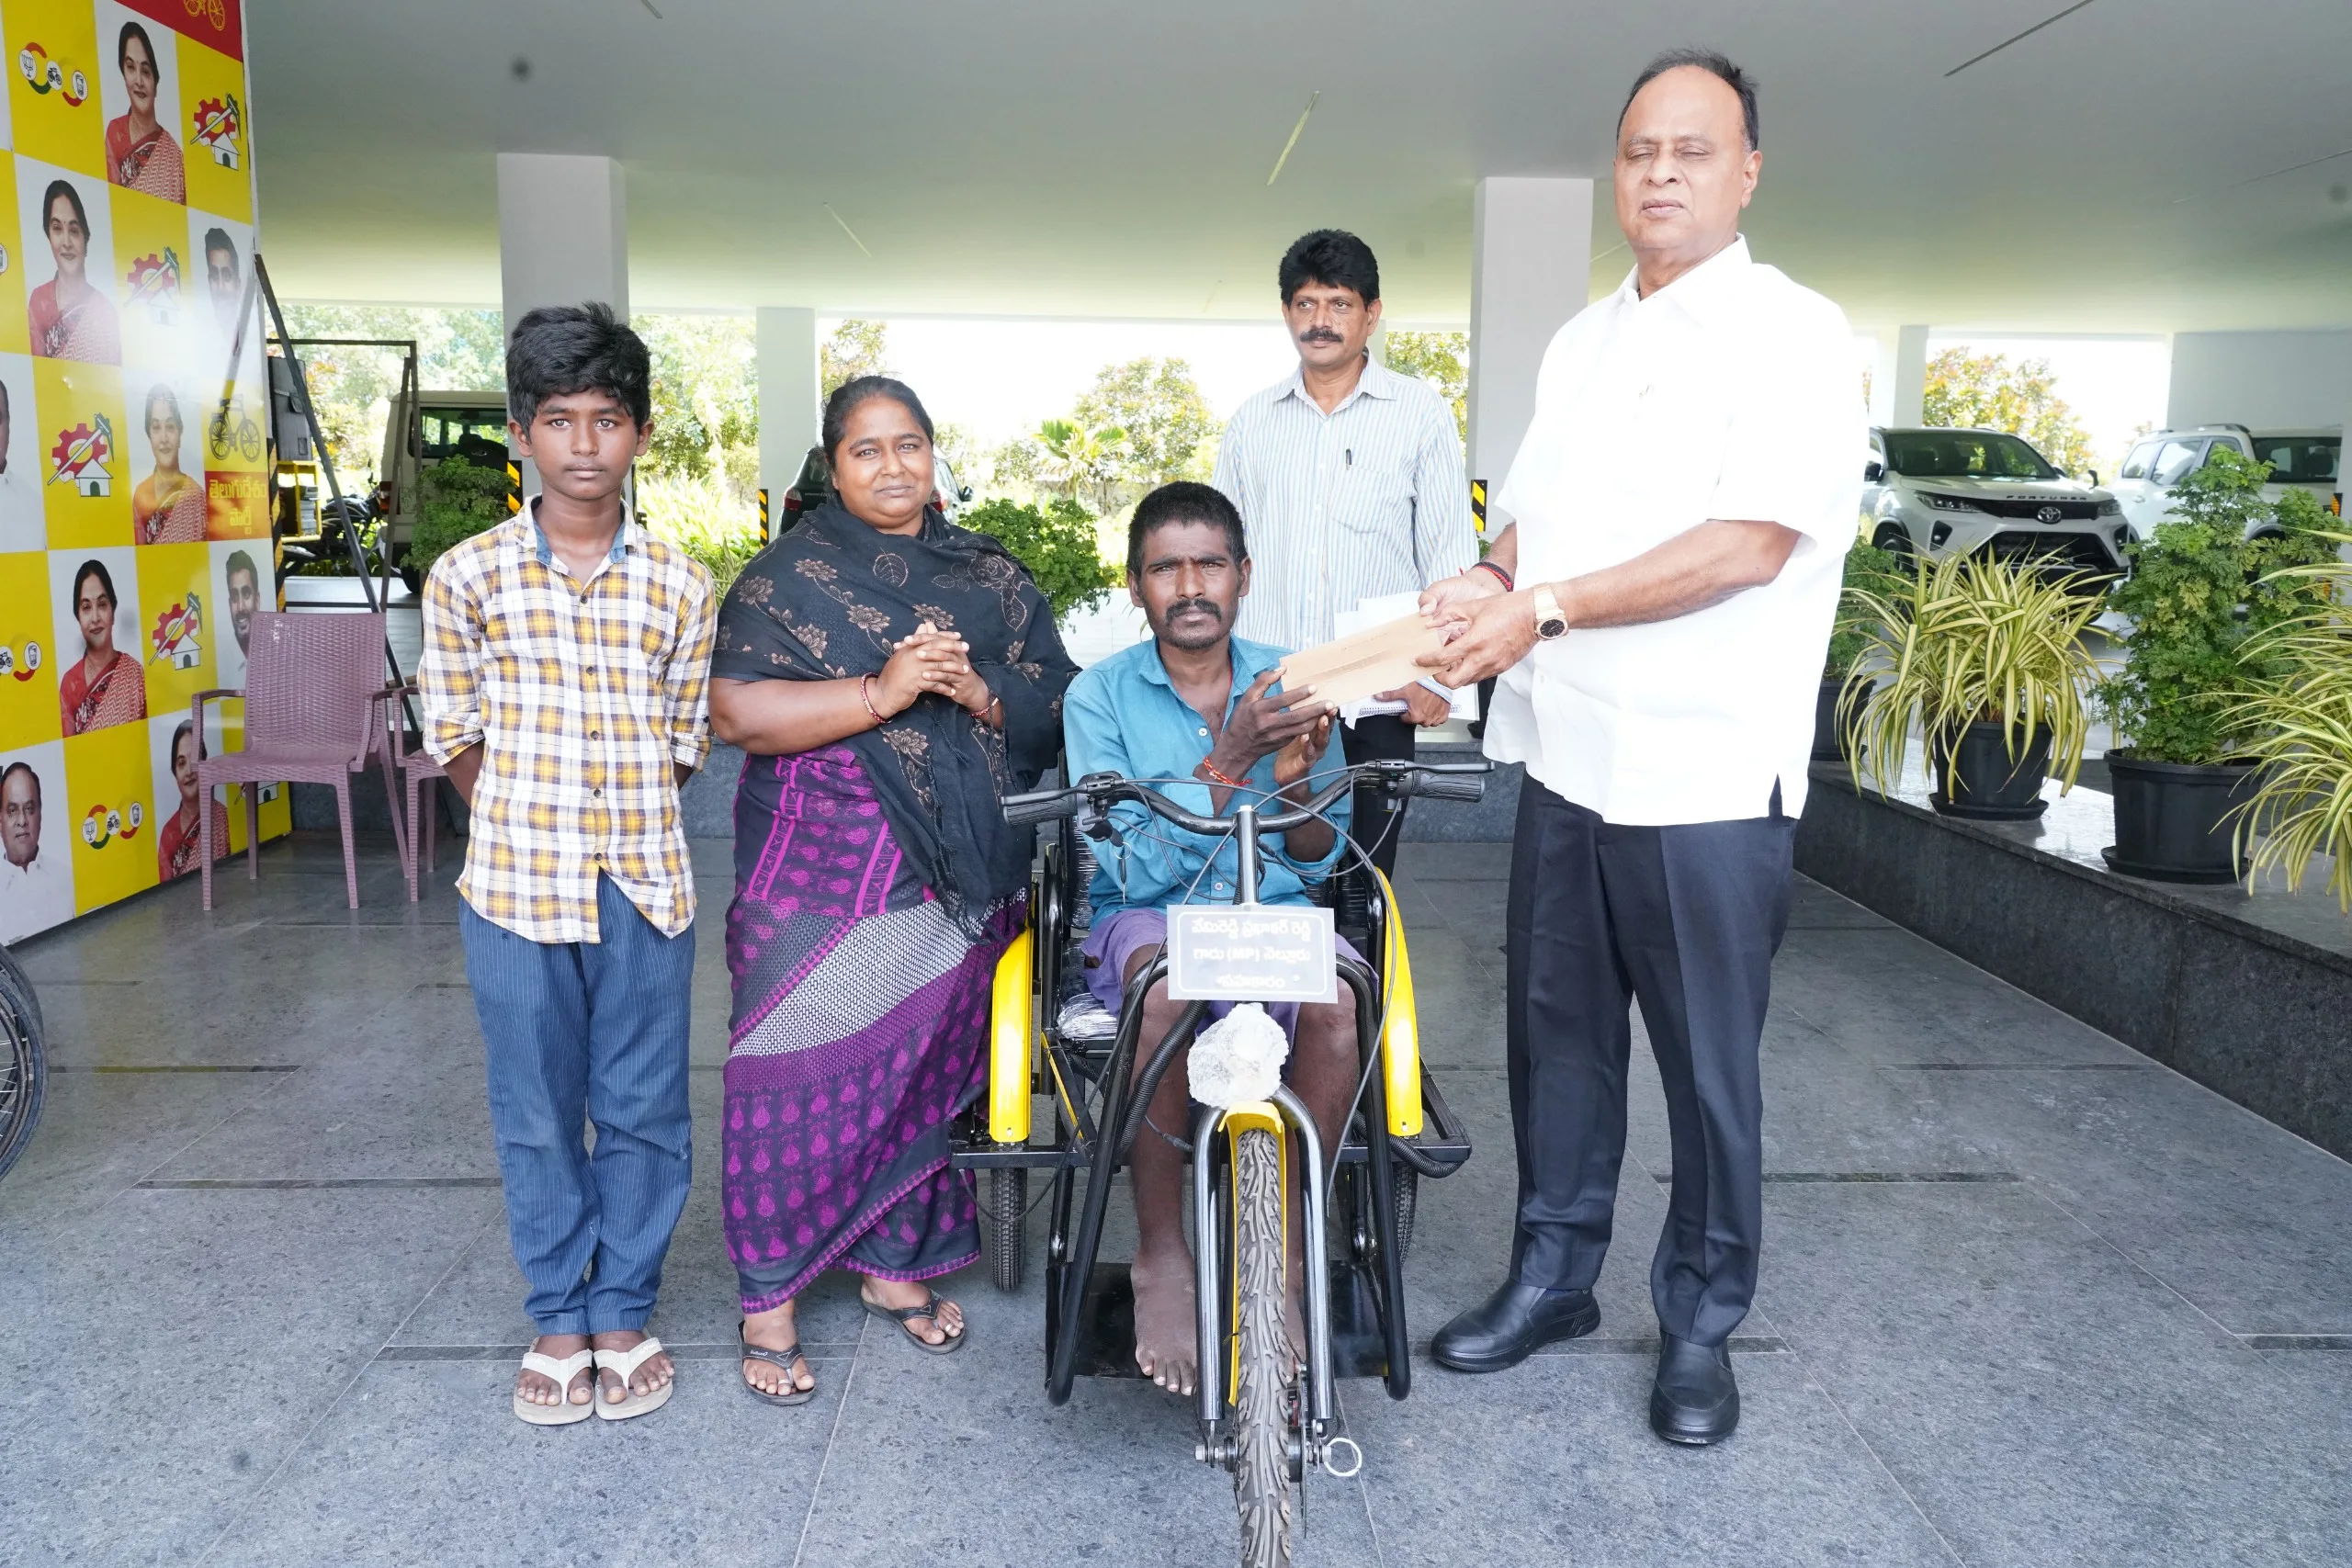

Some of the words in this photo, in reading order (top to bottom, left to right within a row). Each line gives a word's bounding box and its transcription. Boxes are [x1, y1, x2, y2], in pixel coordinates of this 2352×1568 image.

[209, 476, 266, 499] తెలుగుదేశం
[230, 506, 252, 535] పార్టీ
[1191, 917, 1238, 939] వేమిరెడ్డి
[1241, 919, 1288, 937] ప్రభాకర్
[1291, 919, 1312, 942] రెడ్డి
[1193, 947, 1225, 960] గారు
[1227, 947, 1260, 962] (MP)
[1263, 946, 1311, 964] నెల్లూరు
